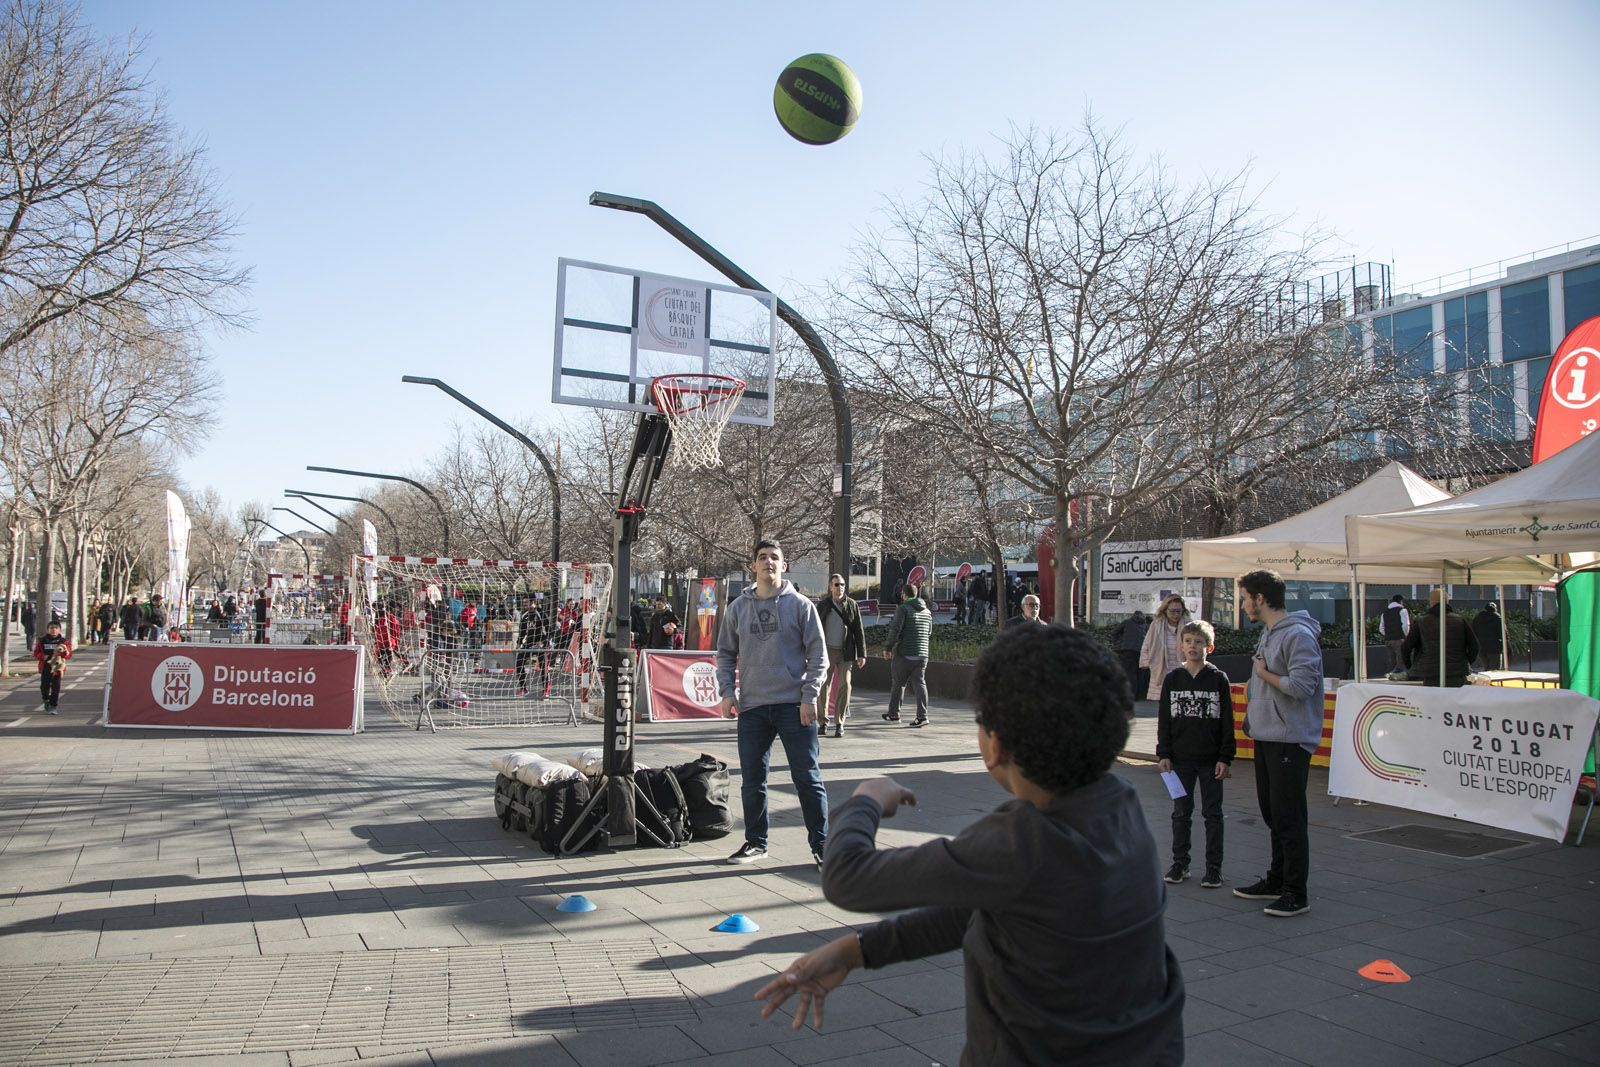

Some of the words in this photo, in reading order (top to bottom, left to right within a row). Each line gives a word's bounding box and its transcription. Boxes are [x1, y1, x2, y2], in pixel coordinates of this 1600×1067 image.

[664, 297, 688, 310] CIUTAT
[690, 301, 701, 314] DEL
[1465, 525, 1517, 539] Ajuntament
[1551, 523, 1565, 531] de
[1256, 556, 1289, 566] Ajuntament
[1307, 557, 1316, 565] de
[213, 665, 317, 686] Diputació
[212, 688, 315, 708] Barcelona
[1443, 711, 1492, 732] SANT
[1502, 718, 1574, 741] CUGAT
[1472, 735, 1542, 758] 2018
[1443, 750, 1494, 771] CIUTAT
[1498, 758, 1572, 785] EUROPEA
[1459, 772, 1480, 788] DE
[1484, 775, 1557, 803] L'ESPORT
